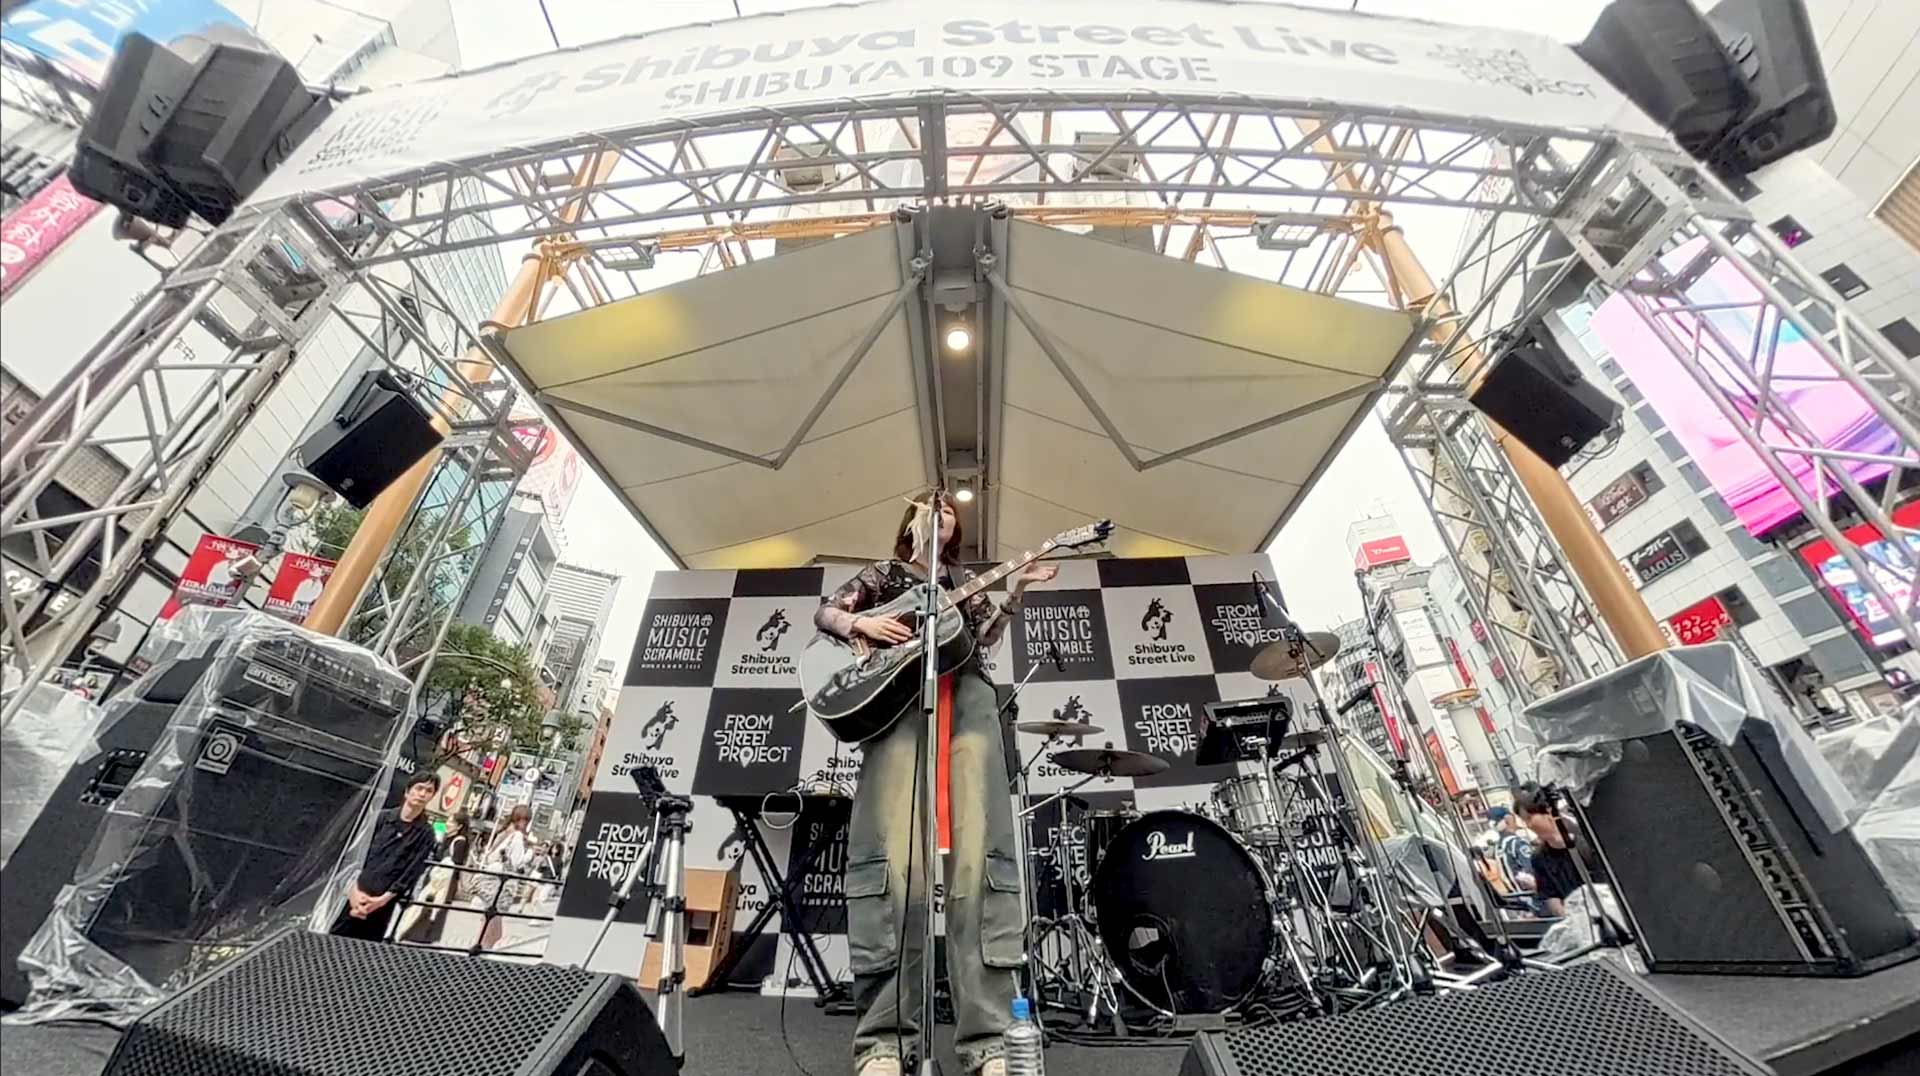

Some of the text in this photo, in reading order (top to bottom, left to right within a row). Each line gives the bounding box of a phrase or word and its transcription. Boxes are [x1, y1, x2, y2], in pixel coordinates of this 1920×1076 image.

[575, 29, 915, 93] Shibuya
[942, 18, 1224, 49] Street
[1233, 25, 1400, 65] Live
[1028, 54, 1218, 82] STAGE
[1023, 606, 1077, 620] SHIBUYA
[1216, 603, 1261, 618] FROM
[652, 614, 701, 627] SHIBUYA
[1211, 617, 1262, 632] STREET
[646, 627, 710, 648] MUSIC
[1025, 619, 1093, 642] MUSIC
[1223, 628, 1287, 648] PROJECT
[642, 647, 704, 661] SCRAMBLE
[1134, 643, 1186, 656] Shibuya
[740, 654, 791, 664] Shibuya
[1128, 652, 1196, 665] Street Live
[731, 663, 797, 675] Street Live
[1141, 703, 1193, 720] FROM
[724, 715, 774, 730] FROM
[1135, 719, 1193, 737] STREET
[713, 730, 771, 746] STREET
[623, 752, 674, 766] Shibuya
[718, 746, 792, 768] PROJECT
[598, 823, 649, 843] FROM
[1142, 831, 1195, 860] Pearl
